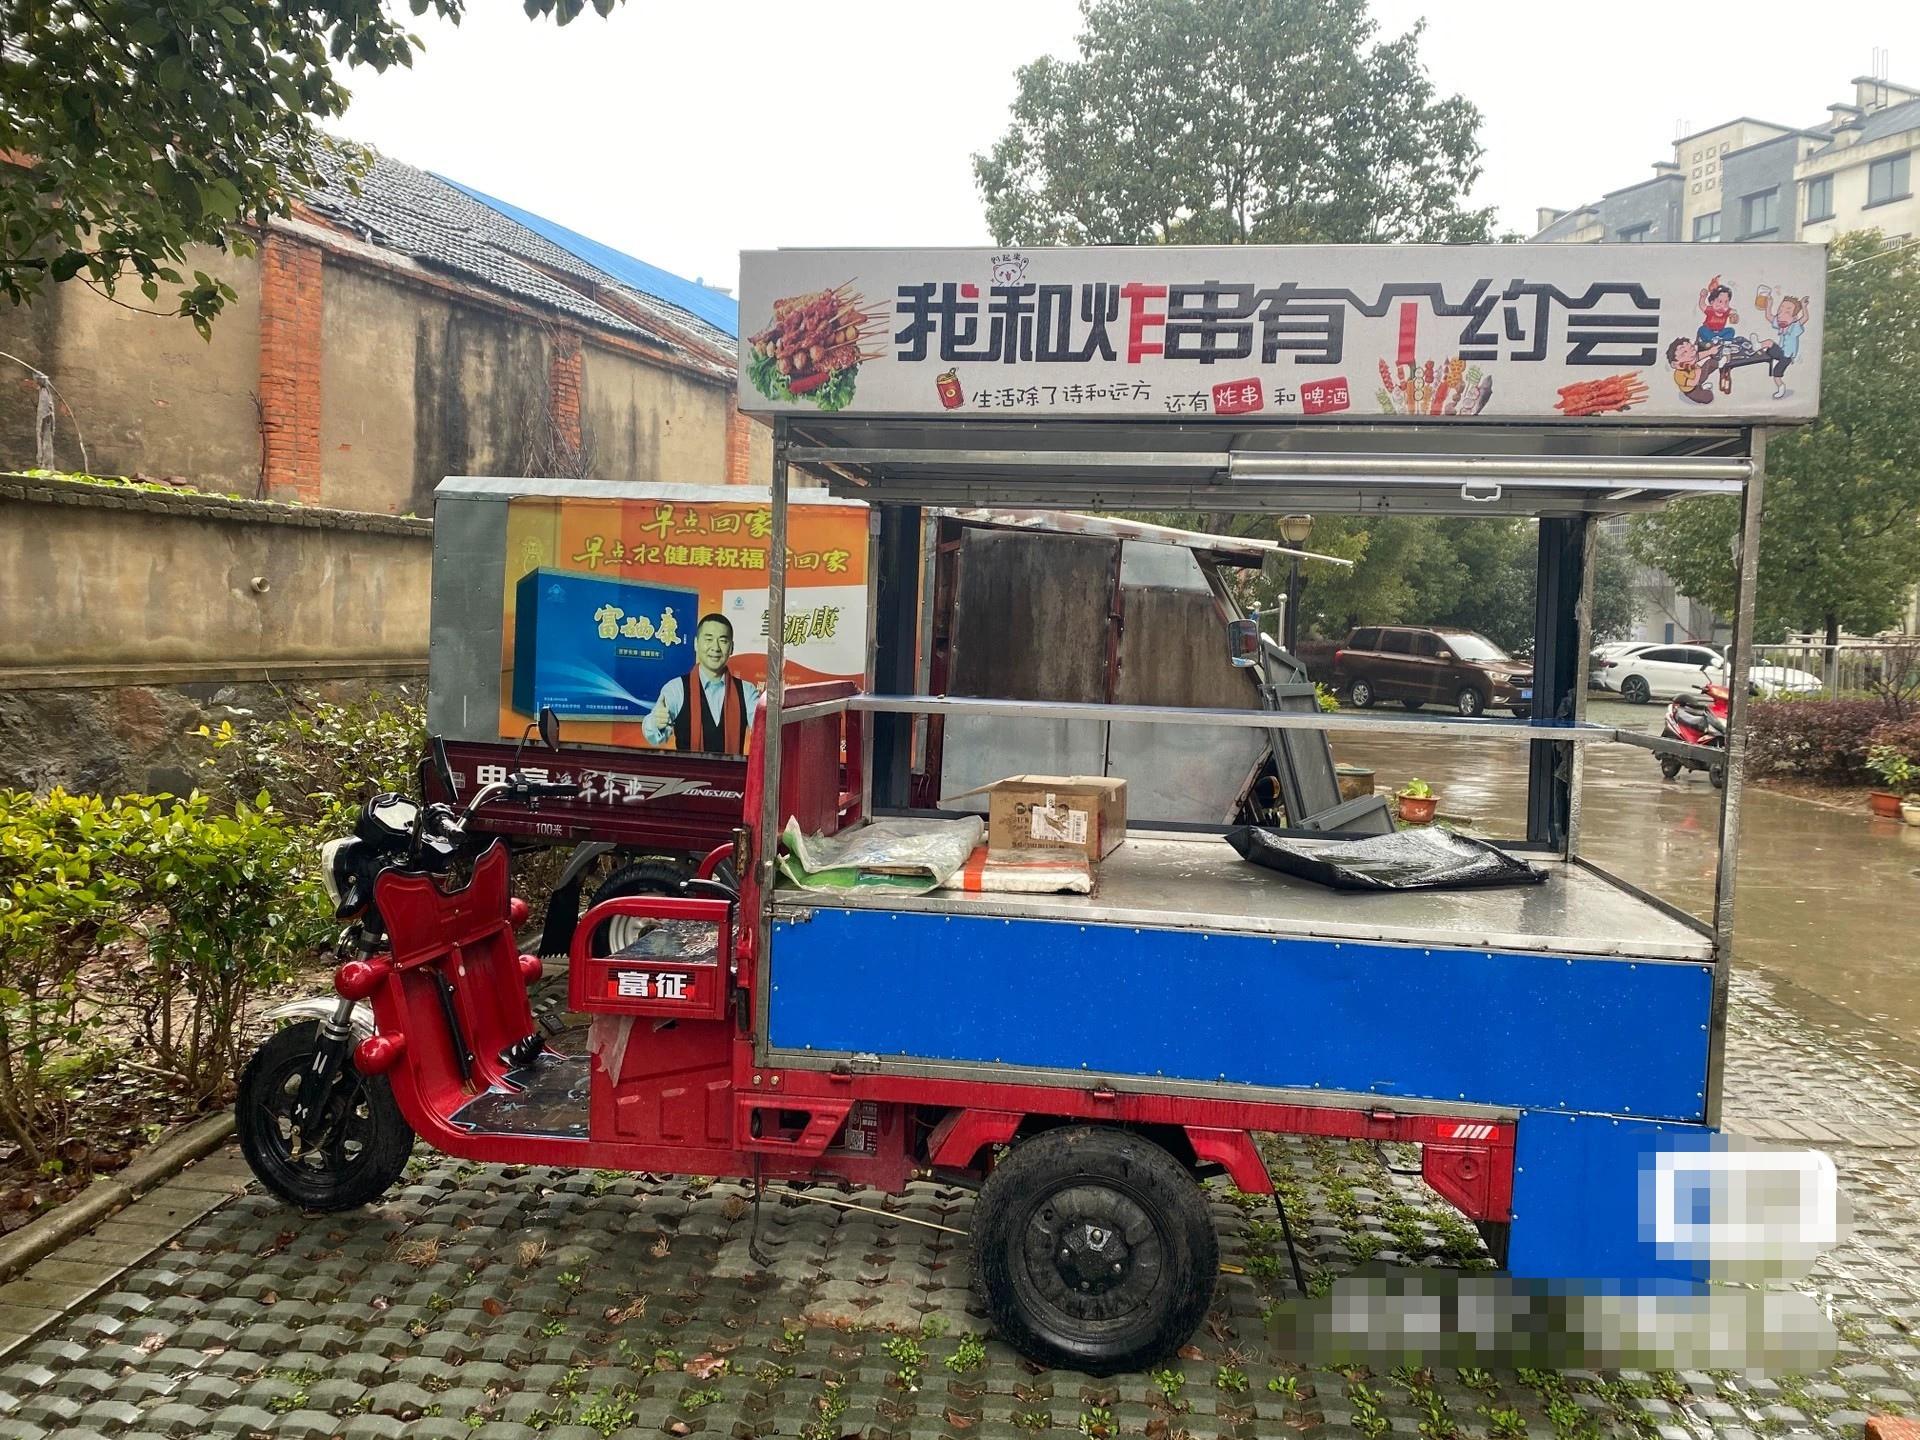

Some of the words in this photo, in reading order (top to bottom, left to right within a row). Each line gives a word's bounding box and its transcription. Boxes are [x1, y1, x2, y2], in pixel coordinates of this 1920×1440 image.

[895, 279, 1661, 365] 我和炸串有个约会
[973, 380, 1151, 408] 生活除了诗和远方
[641, 504, 773, 539] 早点回家
[573, 537, 850, 572] 早点把健康祝福回家
[617, 971, 688, 999] 富征
